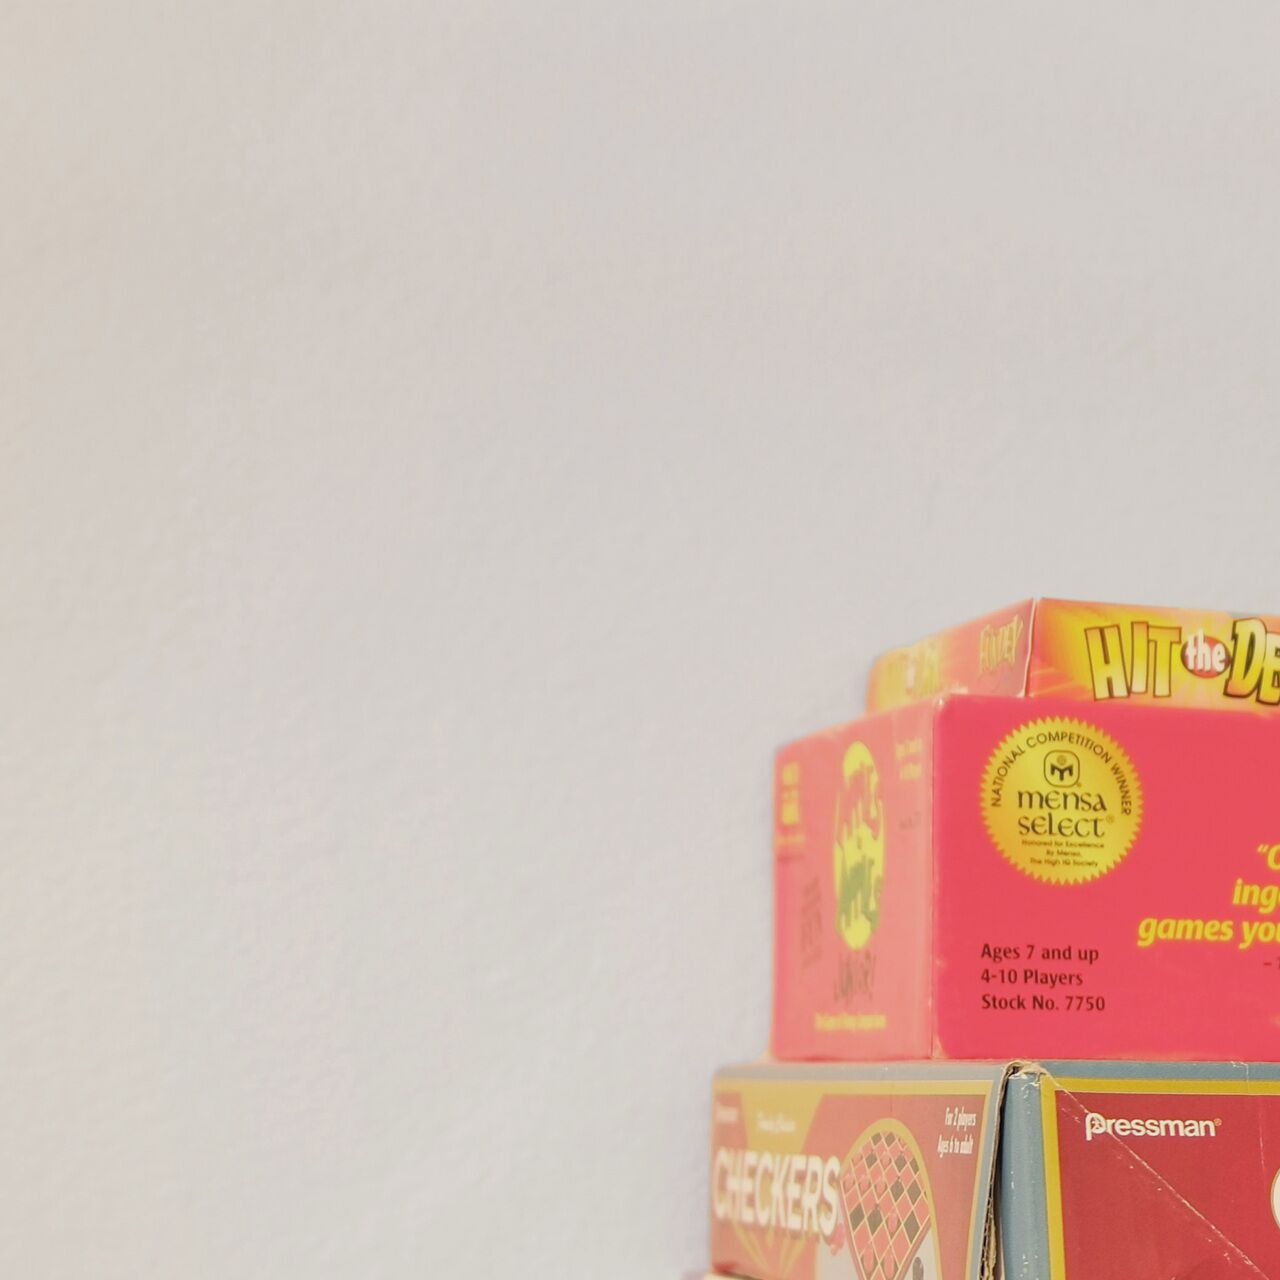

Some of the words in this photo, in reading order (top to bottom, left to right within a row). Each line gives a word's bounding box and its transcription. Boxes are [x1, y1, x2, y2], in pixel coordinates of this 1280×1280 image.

[1084, 621, 1182, 701] HIT
[1186, 628, 1227, 673] the
[991, 744, 1026, 809] NATIONAL
[1026, 731, 1113, 765] COMPETITION
[1110, 762, 1132, 817] WINNER
[1017, 790, 1108, 813] mensa
[1017, 812, 1106, 838] select
[1137, 917, 1234, 947] games
[980, 943, 1021, 963] Ages
[1026, 944, 1036, 960] 7
[1041, 945, 1073, 961] and
[1078, 948, 1099, 965] up
[980, 968, 1018, 985] 4-10
[1023, 968, 1084, 989] Players
[981, 993, 1026, 1010] Stock
[1032, 995, 1060, 1011] No.
[1065, 995, 1106, 1012] 7750
[713, 1149, 840, 1237] CHECKERS
